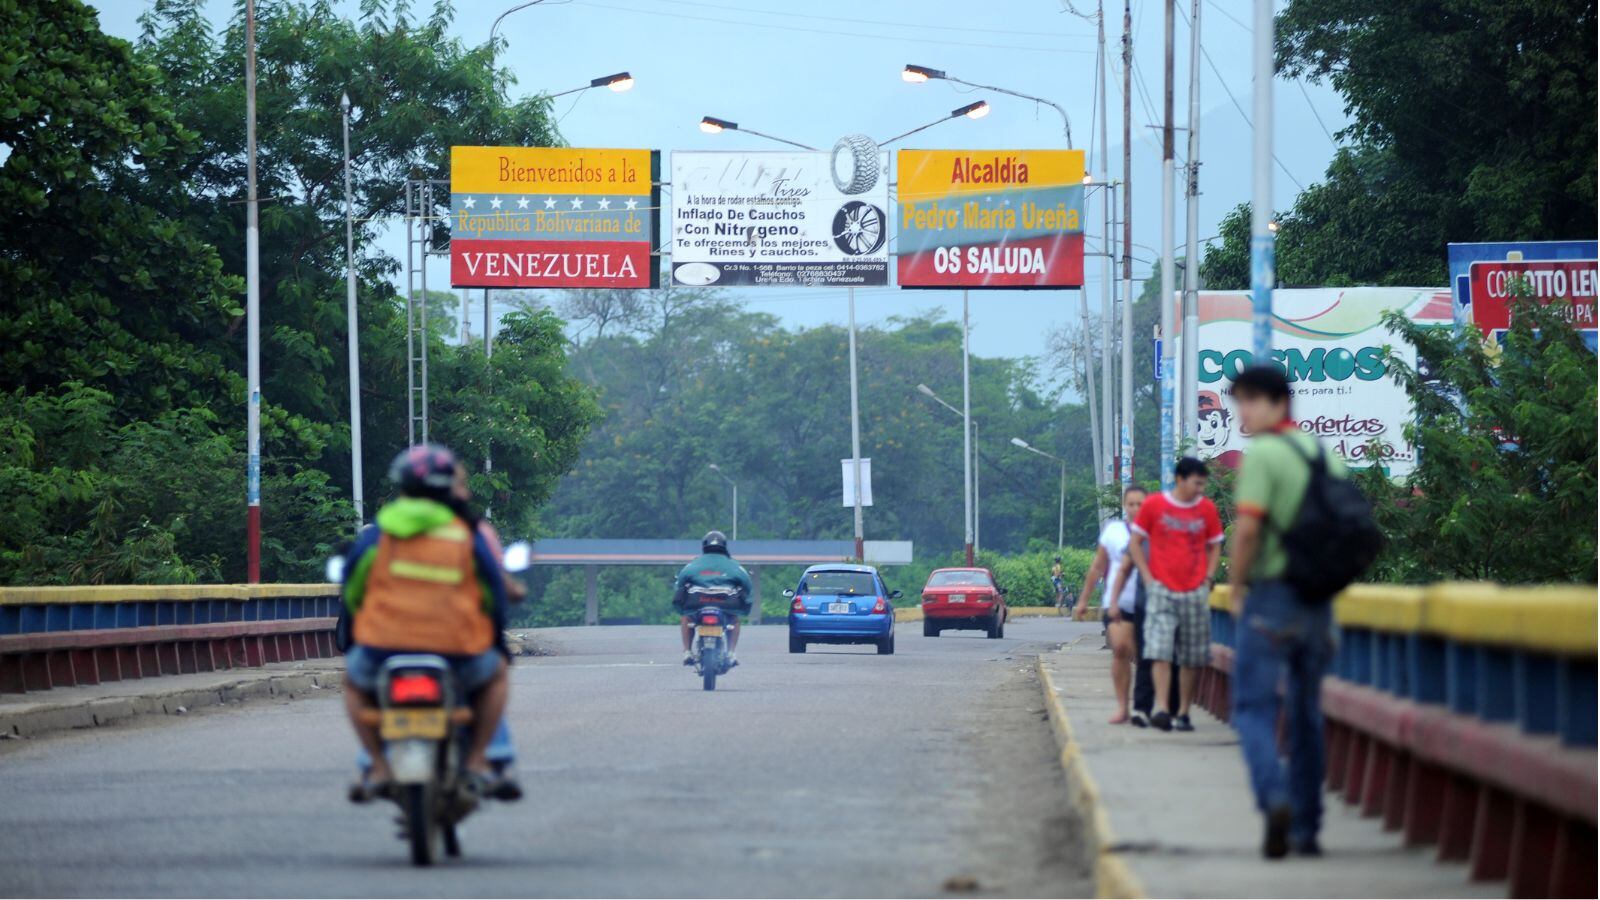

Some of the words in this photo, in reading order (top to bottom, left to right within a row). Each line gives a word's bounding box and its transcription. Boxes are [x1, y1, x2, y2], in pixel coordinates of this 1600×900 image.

[498, 156, 602, 183] Bienvenidos
[608, 170, 616, 183] a
[622, 158, 637, 183] la
[951, 157, 1029, 184] Alcaldía
[771, 178, 812, 197] Tires
[687, 195, 694, 205] A
[695, 195, 700, 205] la
[701, 195, 717, 205] hora
[718, 195, 726, 205] de
[727, 195, 745, 205] rodar
[458, 209, 530, 237] Republica
[535, 209, 620, 234] Bolivariana
[624, 212, 641, 234] de
[678, 208, 723, 219] Inflado
[728, 209, 745, 220] De
[748, 209, 806, 220] Cauchos
[902, 203, 958, 230] Pedro
[963, 202, 1016, 230] María
[1021, 202, 1079, 230] Ureña
[684, 223, 709, 234] Con
[715, 223, 799, 239] Nitrgeno
[676, 239, 691, 247] Te
[694, 238, 757, 247] ofrecemos
[760, 239, 778, 247] los
[781, 239, 829, 249] mejores
[709, 247, 745, 256] Rines
[749, 249, 756, 258] y
[760, 247, 818, 256] cauchos.
[462, 252, 638, 278] VENEZUELA
[933, 246, 962, 274] OS
[967, 246, 1046, 274] SALUDA
[1521, 269, 1567, 297] OTTO
[1312, 388, 1334, 396] para
